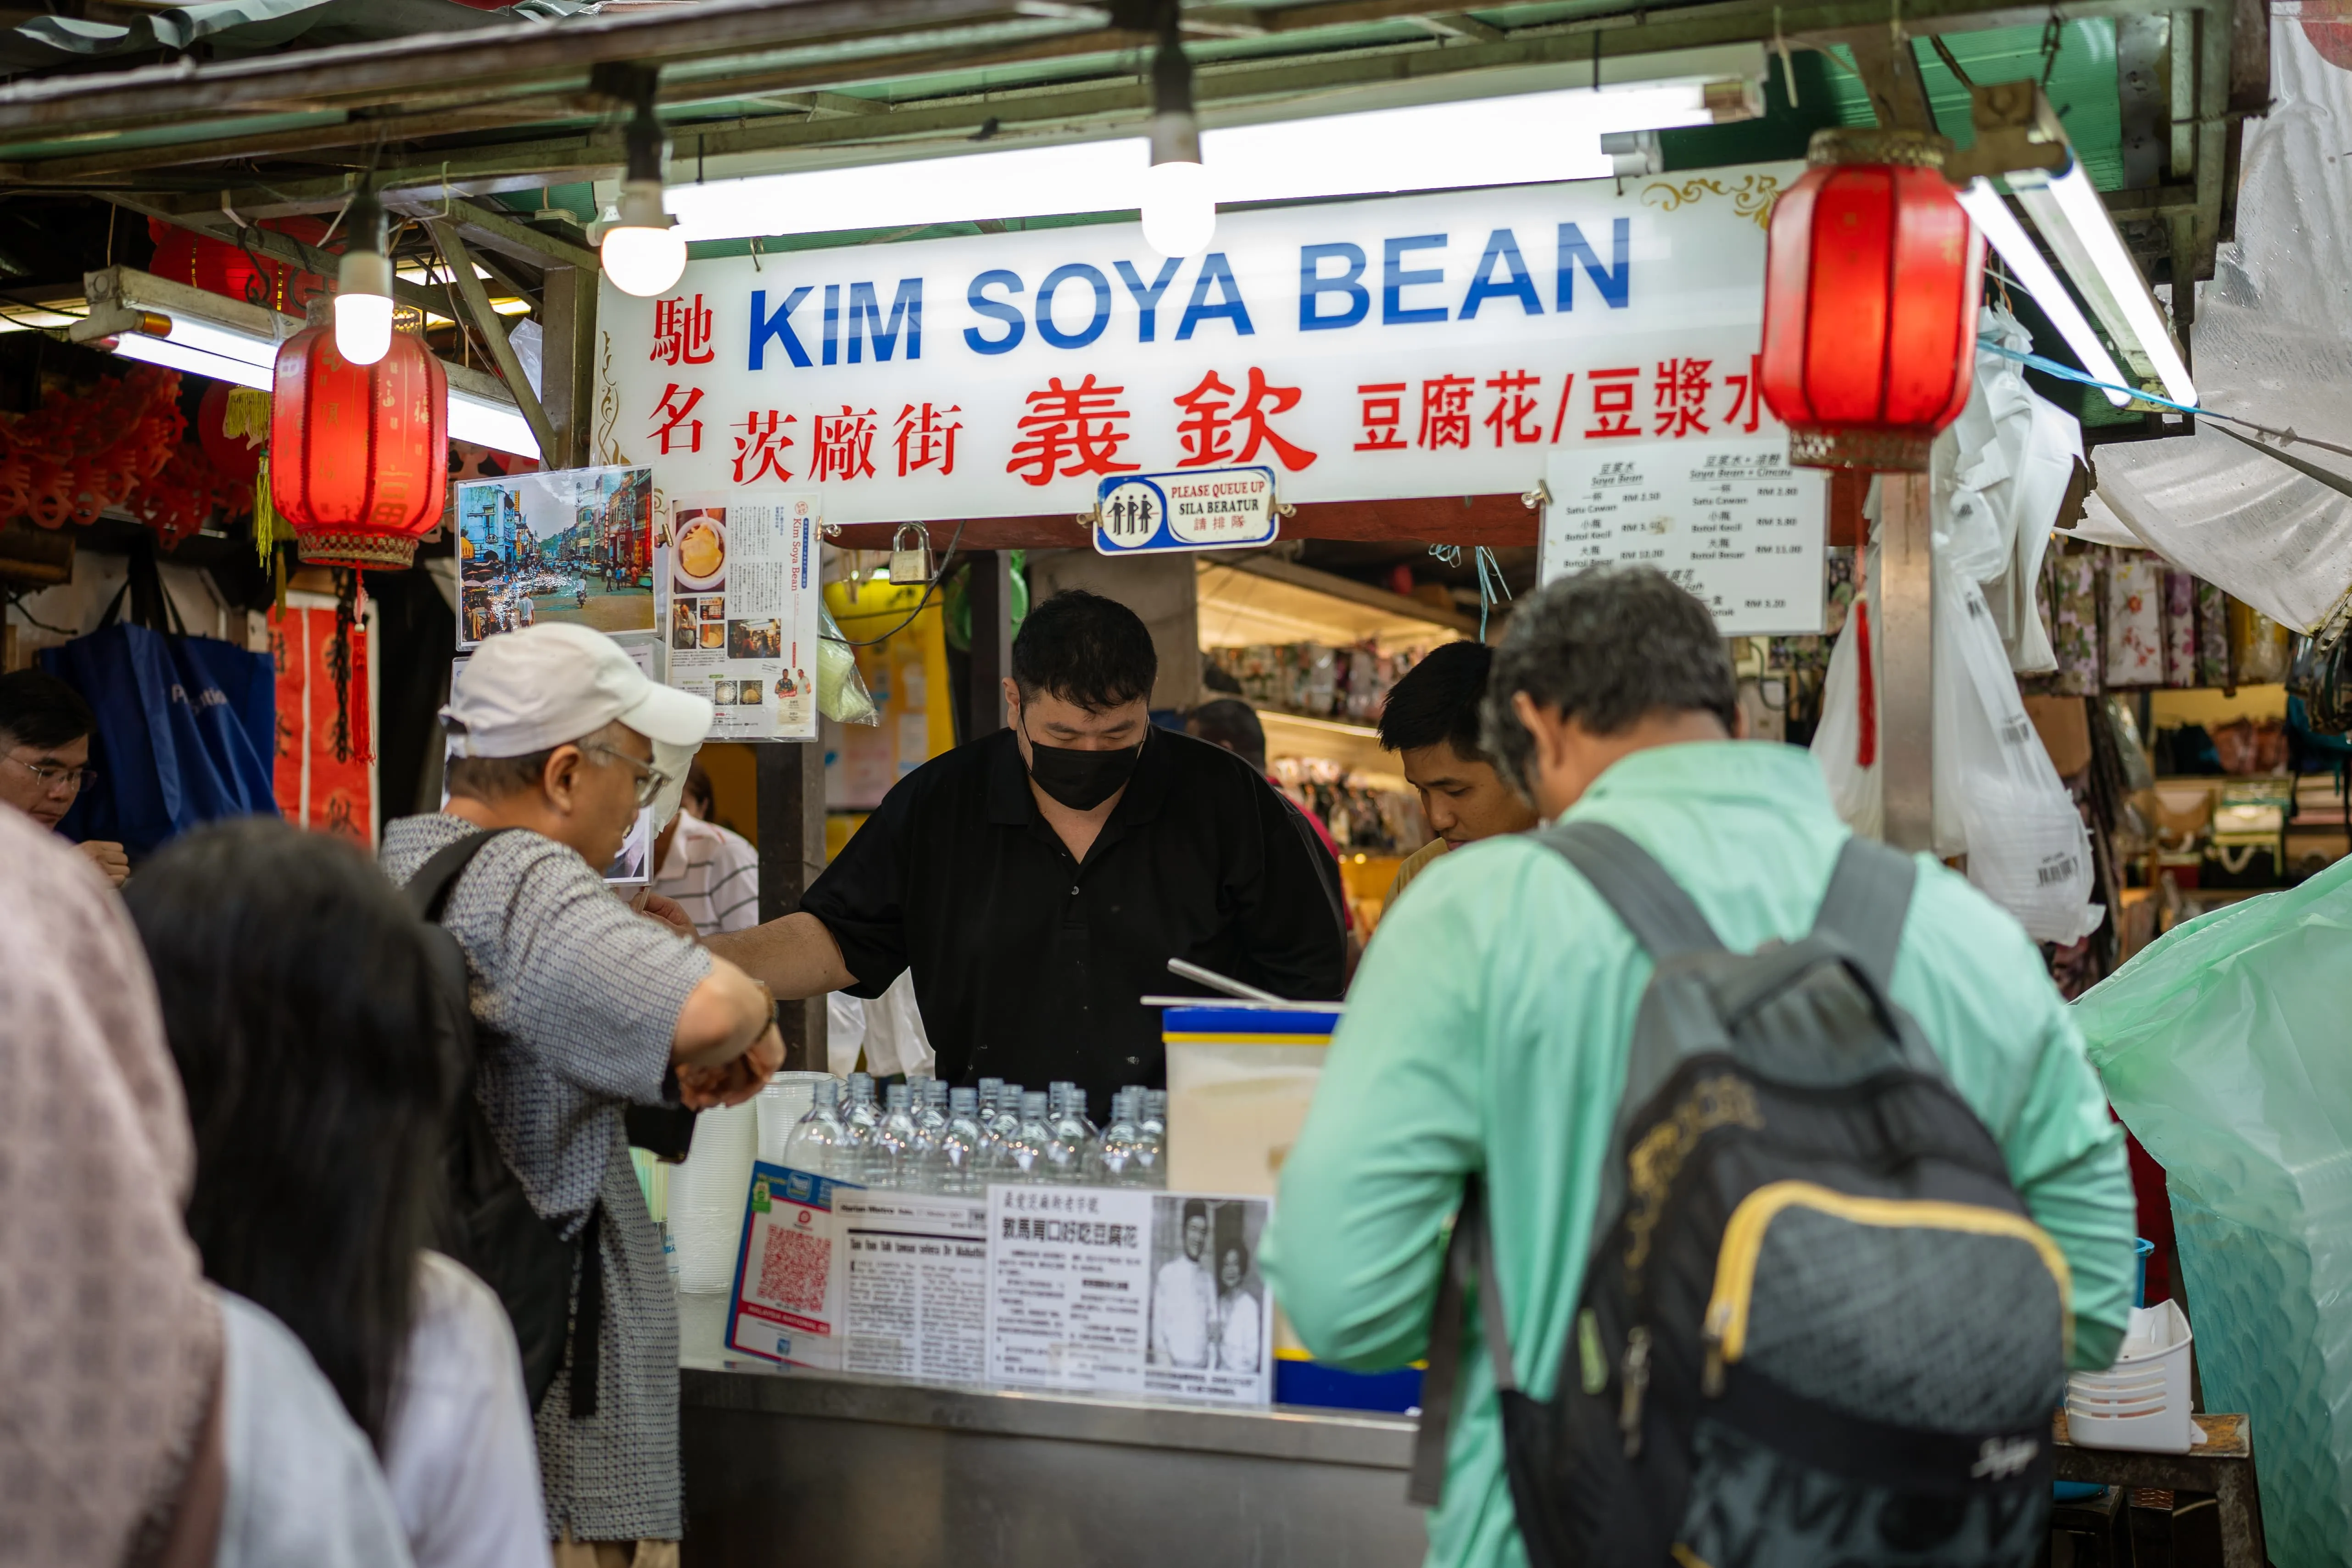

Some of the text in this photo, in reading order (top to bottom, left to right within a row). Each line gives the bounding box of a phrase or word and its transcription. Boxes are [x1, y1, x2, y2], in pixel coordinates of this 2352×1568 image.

[748, 218, 1630, 371] KIM SOYA BEAN
[649, 294, 715, 455] 馳名
[730, 403, 963, 485] 茨廠街
[1591, 474, 1643, 486] Soya Bean
[1690, 469, 1715, 480] Soya
[1718, 469, 1744, 478] Bean
[1171, 481, 1265, 499] PLEASE QUEUE UP
[1757, 487, 1774, 496] RM
[1179, 498, 1259, 515] SILA BERATUR
[1566, 505, 1617, 515] Satu Cawan
[1194, 515, 1245, 531] 請排隊
[1756, 518, 1773, 526] RM
[793, 518, 802, 539] Kim
[1692, 524, 1743, 533] Botol Kecil
[1565, 531, 1612, 542] Botol Kecil
[790, 541, 801, 564] Soya
[1756, 545, 1772, 553] RM
[1620, 552, 1637, 560] RM
[1564, 560, 1586, 568] Botol
[791, 567, 800, 591] Bean
[1744, 599, 1762, 608] RM
[943, 1243, 953, 1256] Dr
[748, 1304, 782, 1320] MALAYSIA
[782, 1313, 817, 1329] NATIONAL
